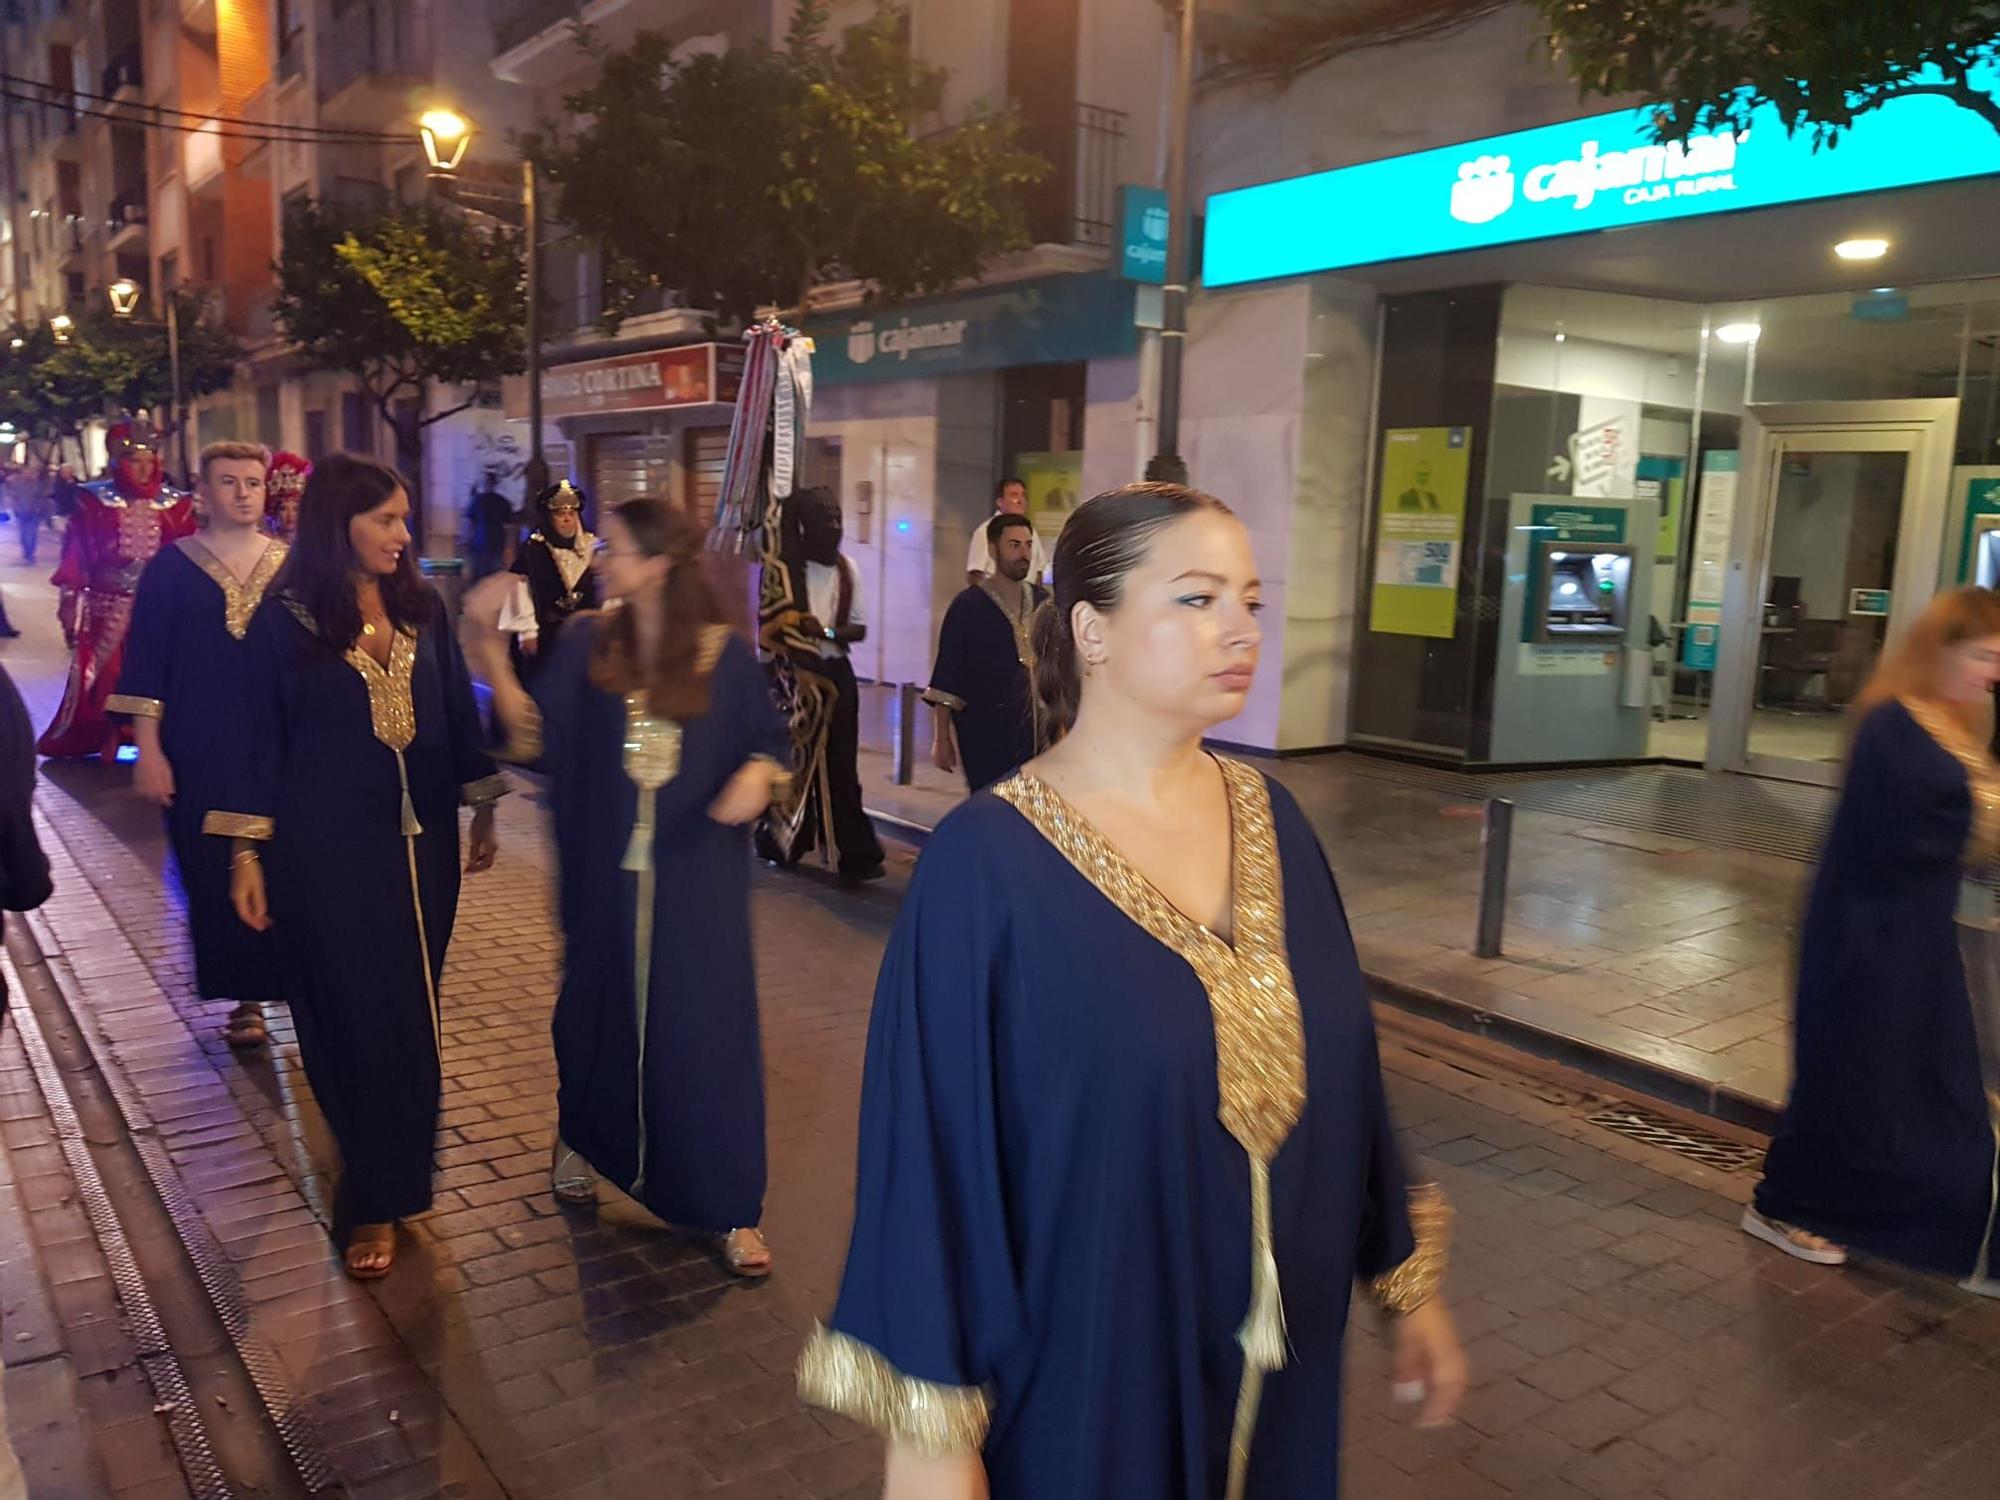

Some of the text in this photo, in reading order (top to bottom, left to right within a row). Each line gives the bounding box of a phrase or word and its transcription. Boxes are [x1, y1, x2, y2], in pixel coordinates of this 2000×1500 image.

[1522, 129, 1750, 209] cajamar
[1623, 173, 1738, 205] CAJA RURAL
[879, 318, 968, 360] cajamar
[582, 362, 663, 394] CORTINA
